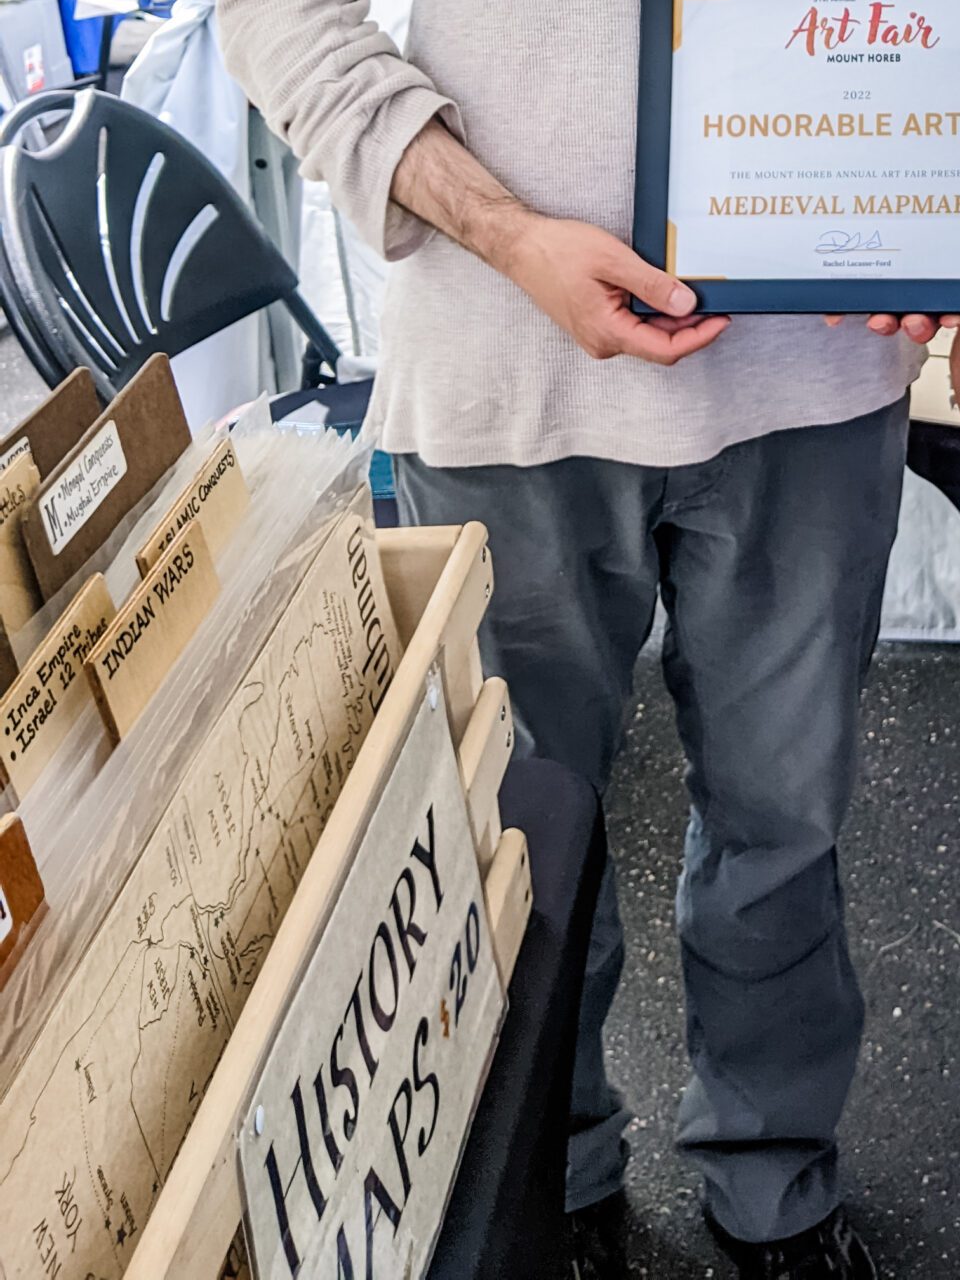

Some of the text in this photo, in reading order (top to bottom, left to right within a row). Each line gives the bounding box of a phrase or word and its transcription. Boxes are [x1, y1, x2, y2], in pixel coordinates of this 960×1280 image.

[784, 2, 940, 56] Art Fair
[826, 53, 902, 63] MOUNT HOREB
[842, 90, 872, 100] 2022
[703, 113, 893, 138] HONORABLE
[730, 171, 751, 180] THE
[754, 170, 794, 179] MOUNT
[796, 170, 833, 179] HOREB
[836, 169, 878, 178] ANNUAL
[881, 169, 902, 178] ART
[904, 169, 928, 178] FAIR
[708, 195, 845, 216] MEDIEVAL
[823, 259, 847, 267] Rachel
[45, 495, 64, 544] M
[66, 464, 118, 527] Mughal Empire
[102, 544, 196, 680] INDIAN WARS
[6, 624, 82, 731] Inca Empire
[15, 618, 109, 754] Israel 12 Tribes
[264, 803, 443, 1280] HISTORY
[55, 1166, 82, 1254] YORK
[33, 1218, 62, 1280] NEW
